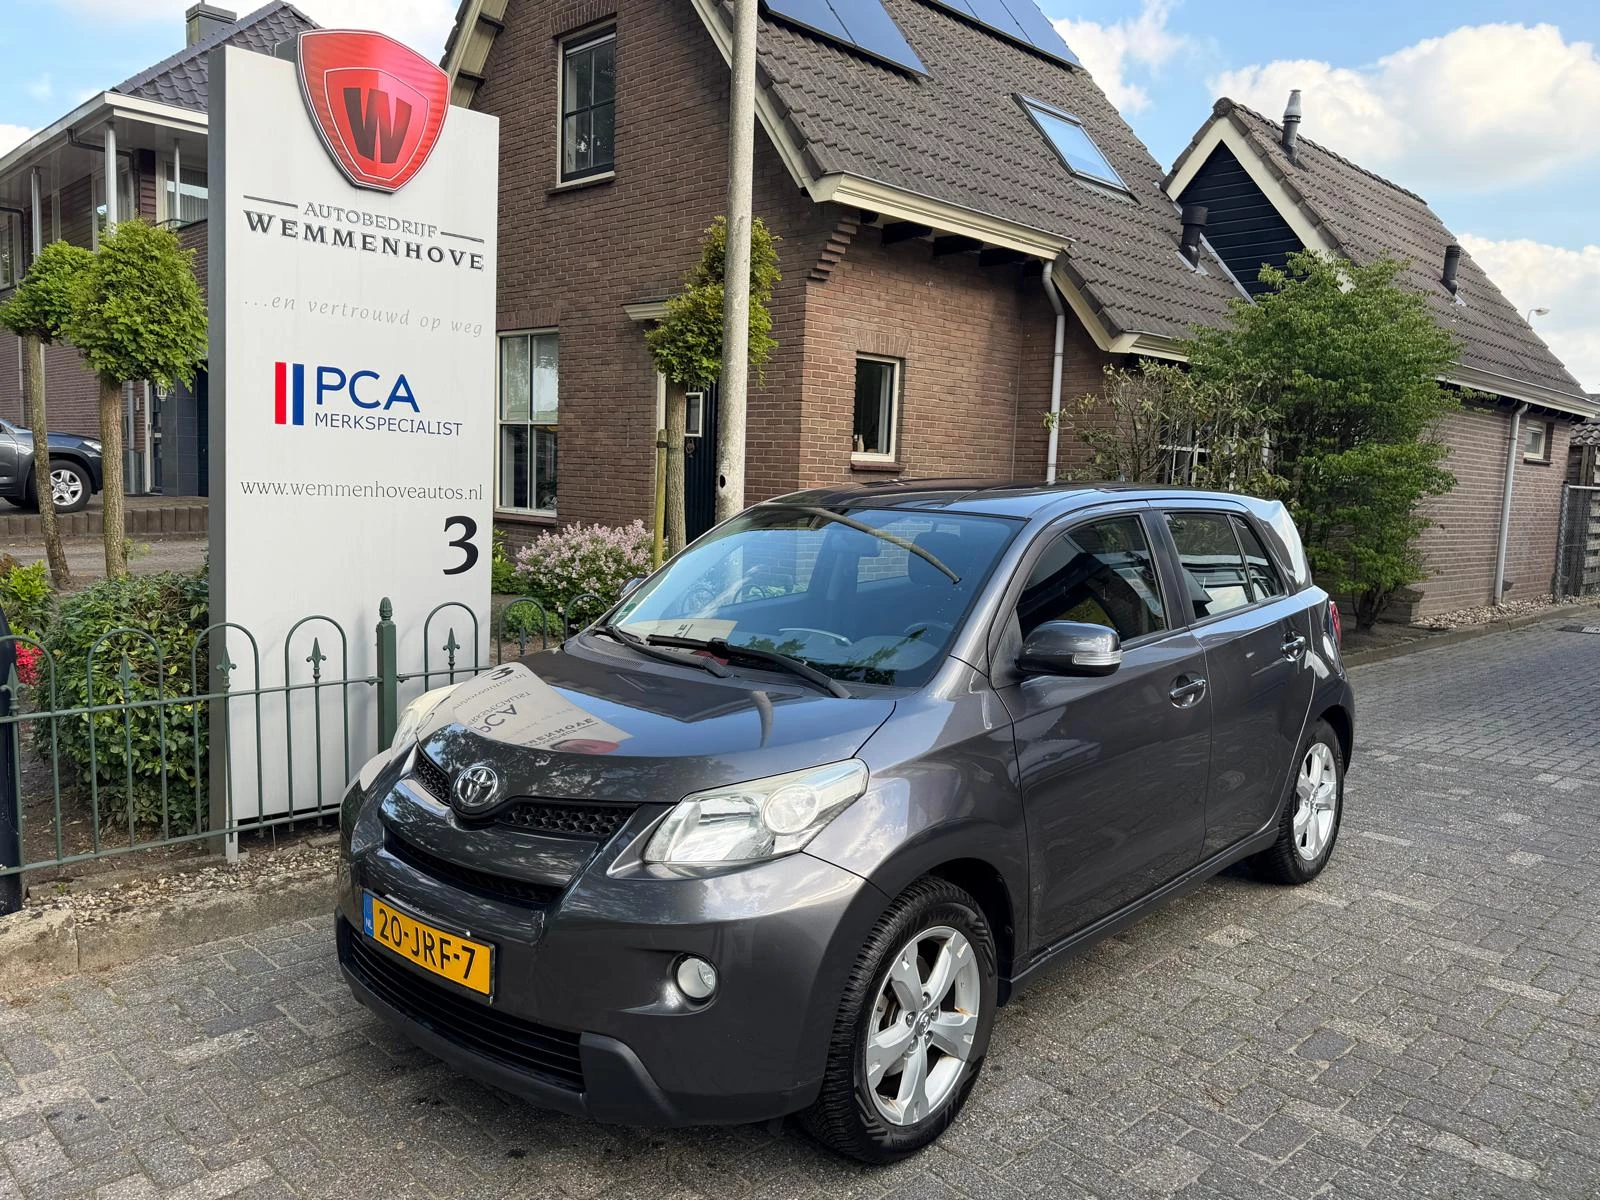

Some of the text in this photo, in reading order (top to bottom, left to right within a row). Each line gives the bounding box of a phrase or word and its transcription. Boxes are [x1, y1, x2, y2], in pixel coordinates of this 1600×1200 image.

[343, 87, 413, 164] W
[243, 209, 485, 272] WEMMENHOVE
[304, 202, 438, 238] AUTOBEDRIJF
[307, 299, 410, 326] vertrouwd
[419, 315, 441, 332] op
[450, 320, 483, 338] weg
[316, 365, 421, 413] PCA
[314, 412, 463, 437] MERKSPECIALIST
[240, 480, 483, 501] www.wemmenhoveautos.nl
[442, 515, 479, 576] 3
[378, 908, 476, 980] 20-JRF-7
